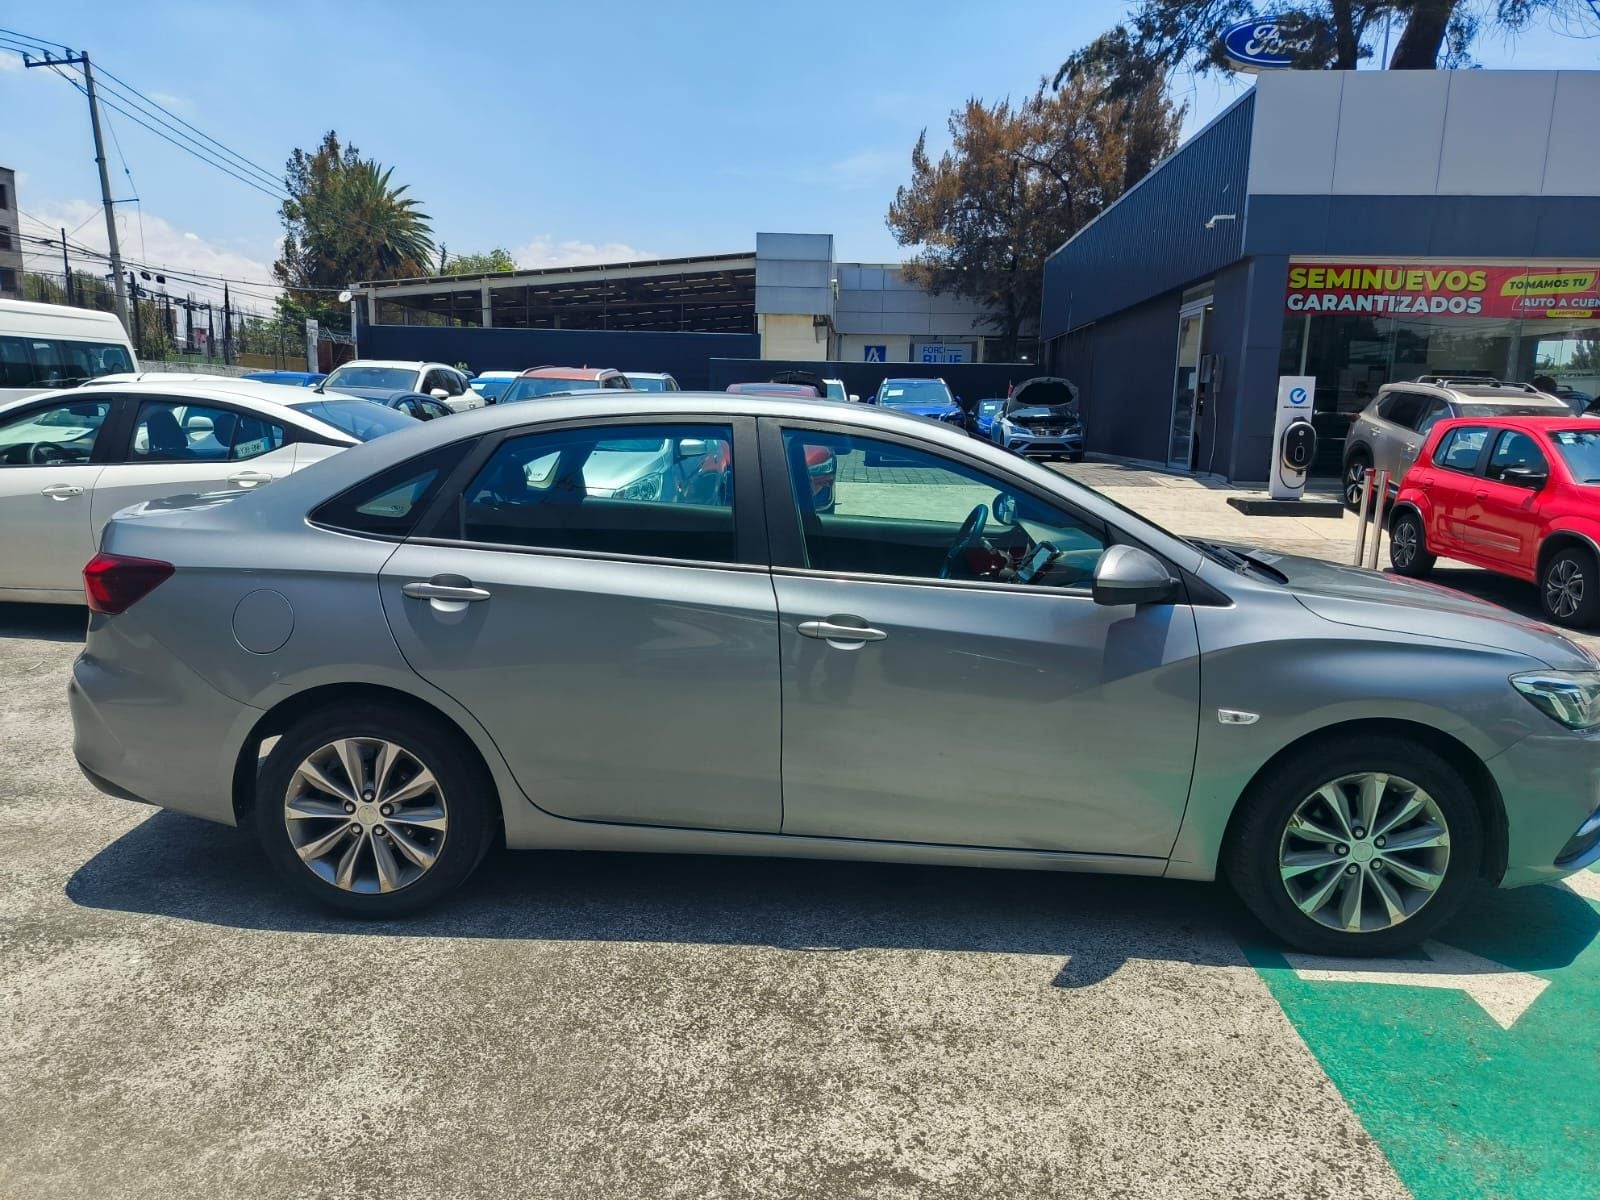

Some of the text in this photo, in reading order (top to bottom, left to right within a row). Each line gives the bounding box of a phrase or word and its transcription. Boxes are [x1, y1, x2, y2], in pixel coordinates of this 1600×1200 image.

[1288, 268, 1487, 292] SEMINUEVOS
[1509, 278, 1588, 290] TOMAMOS TU
[1287, 293, 1482, 314] GARANTIZADOS
[1520, 298, 1555, 307] AUTO
[1559, 298, 1568, 307] A
[922, 346, 946, 354] FORD
